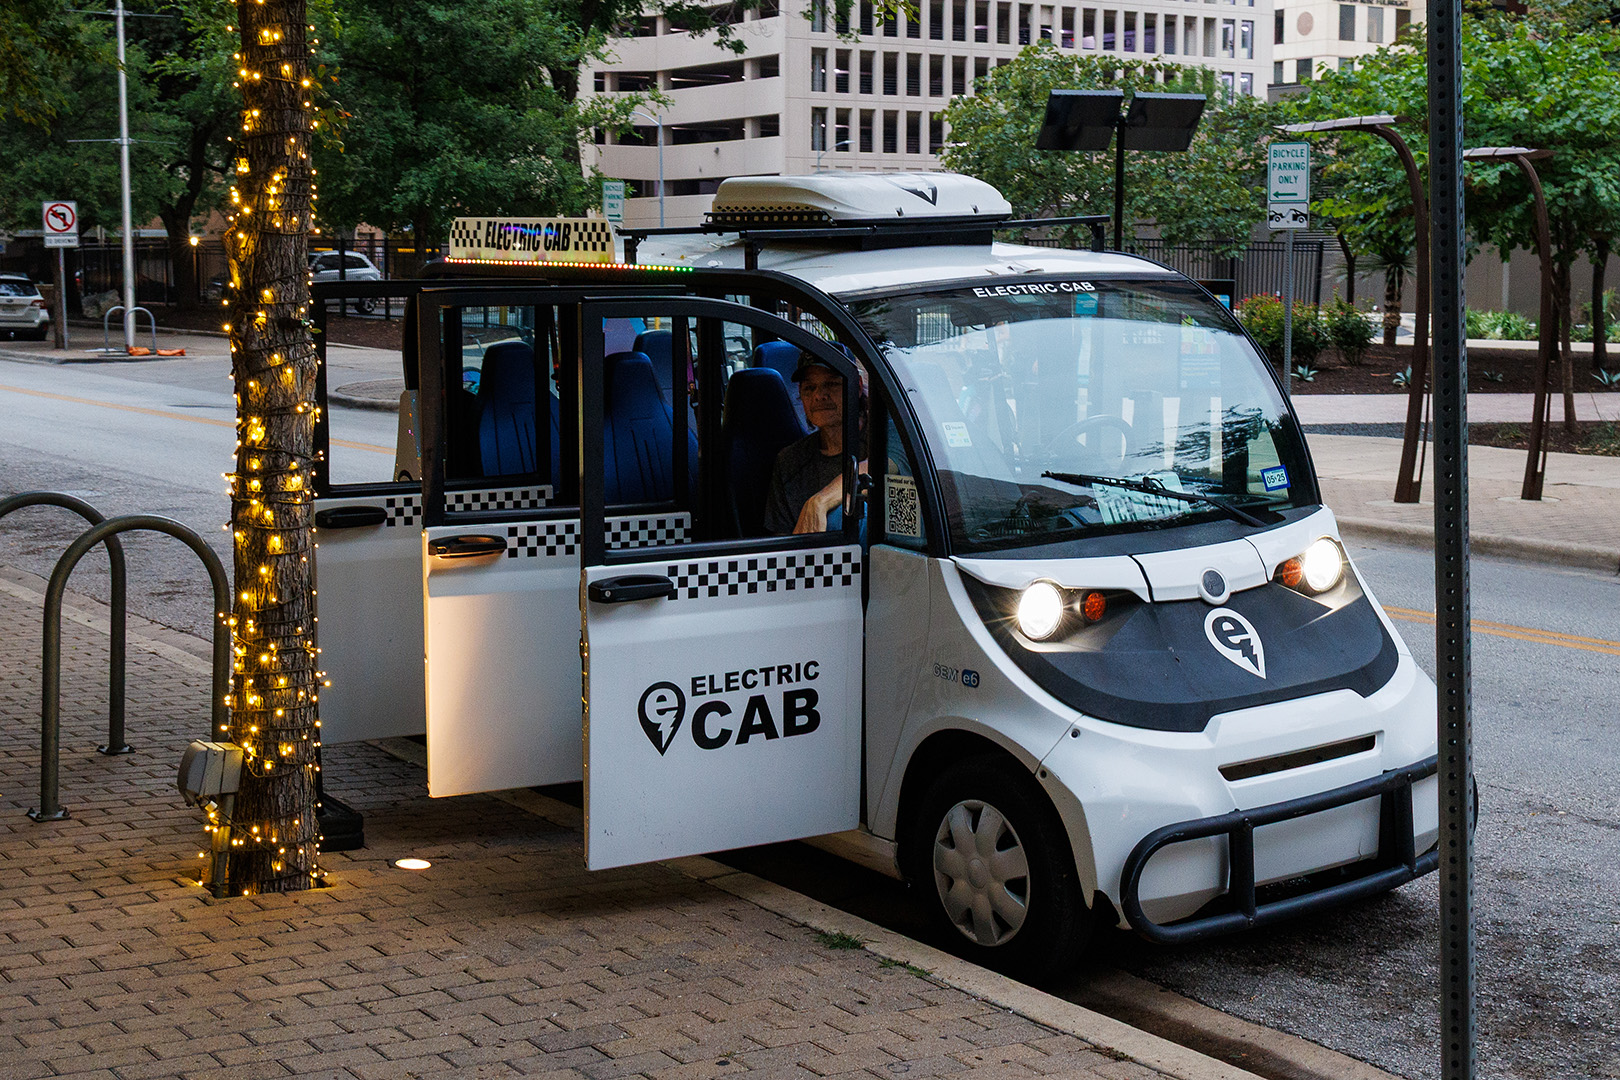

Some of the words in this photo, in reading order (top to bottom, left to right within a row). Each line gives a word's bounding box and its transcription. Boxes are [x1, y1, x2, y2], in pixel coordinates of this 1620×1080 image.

[1272, 148, 1305, 158] BICYCLE
[1272, 161, 1306, 171] PARKING
[1278, 175, 1299, 184] ONLY
[484, 220, 542, 251] ELECTRIC
[543, 222, 572, 252] CAB
[972, 282, 1058, 298] ELECTRIC
[1059, 281, 1096, 293] CAB
[691, 660, 820, 697] ELECTRIC
[691, 687, 821, 750] CAB
